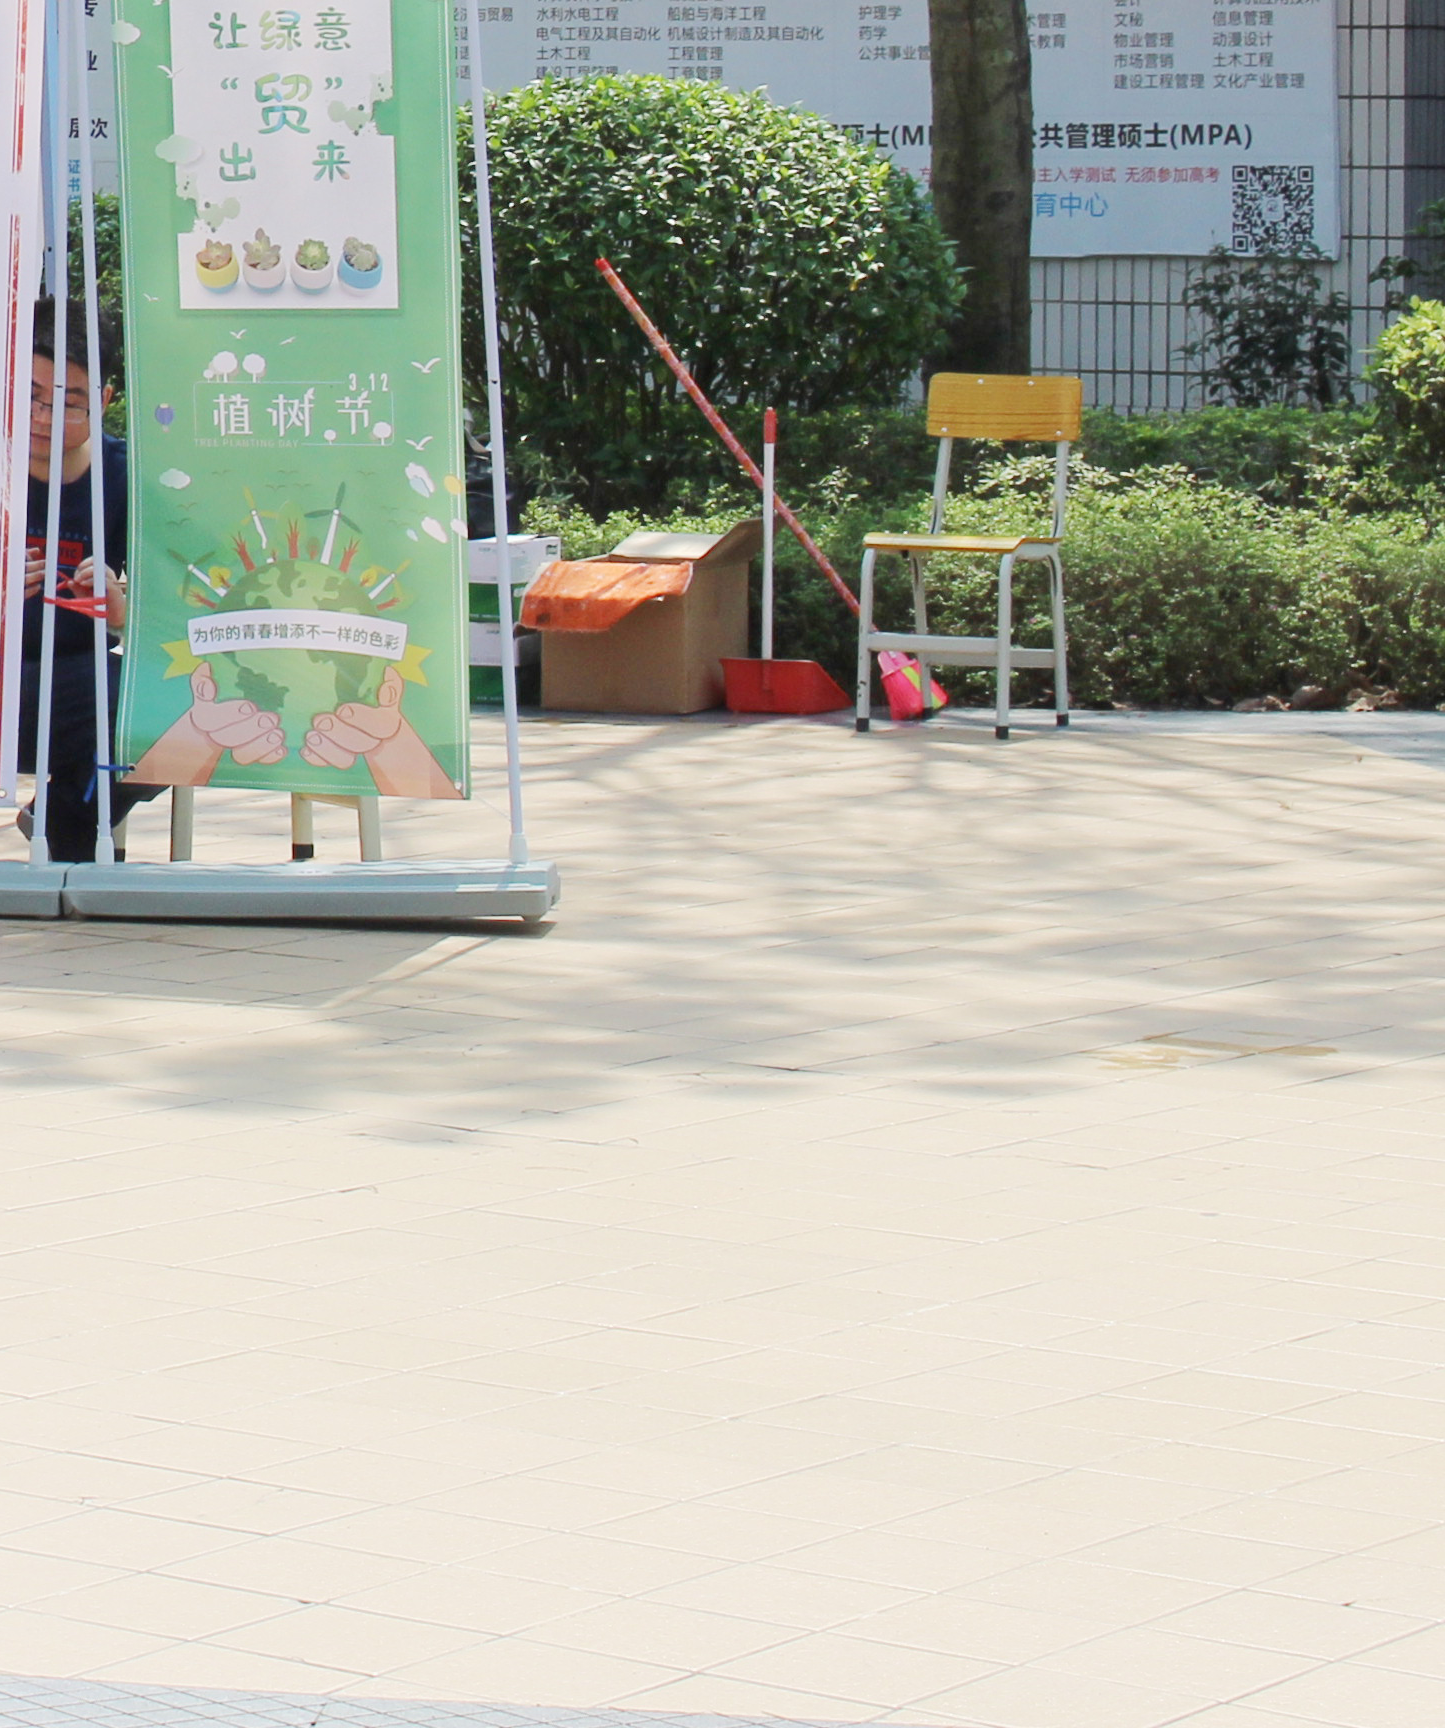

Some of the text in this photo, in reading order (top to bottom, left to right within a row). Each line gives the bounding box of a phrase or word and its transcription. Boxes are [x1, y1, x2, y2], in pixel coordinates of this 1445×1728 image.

[536, 6, 619, 22] 水利水电工程
[667, 6, 767, 22] 船舶与海洋工程
[858, 5, 903, 21] 护理学
[1113, 12, 1144, 28] 文秘
[1211, 10, 1274, 26] 信息管理
[207, 6, 354, 52] 让绿意
[536, 25, 662, 42] 电气工程及其自动化
[667, 25, 825, 42] 机械设计制造及其自动化
[858, 25, 888, 41] 药学
[1113, 32, 1175, 48] 物业管理
[1211, 32, 1274, 48] 动漫设计
[536, 45, 591, 61] 土木工程
[667, 45, 724, 61] 工程管理
[1113, 53, 1175, 69] 市场营销
[1211, 52, 1275, 68] 土木工程
[1113, 73, 1206, 90] 建设工程管理
[1211, 73, 1306, 89] 文化产业管理
[1125, 165, 1220, 184] 无须参加高考
[348, 372, 389, 392] 3.12
[213, 387, 373, 438] 植树节
[194, 438, 299, 449] TREE PLANTING DAY
[193, 621, 401, 652] 为你的青春增添不一样的色彩
